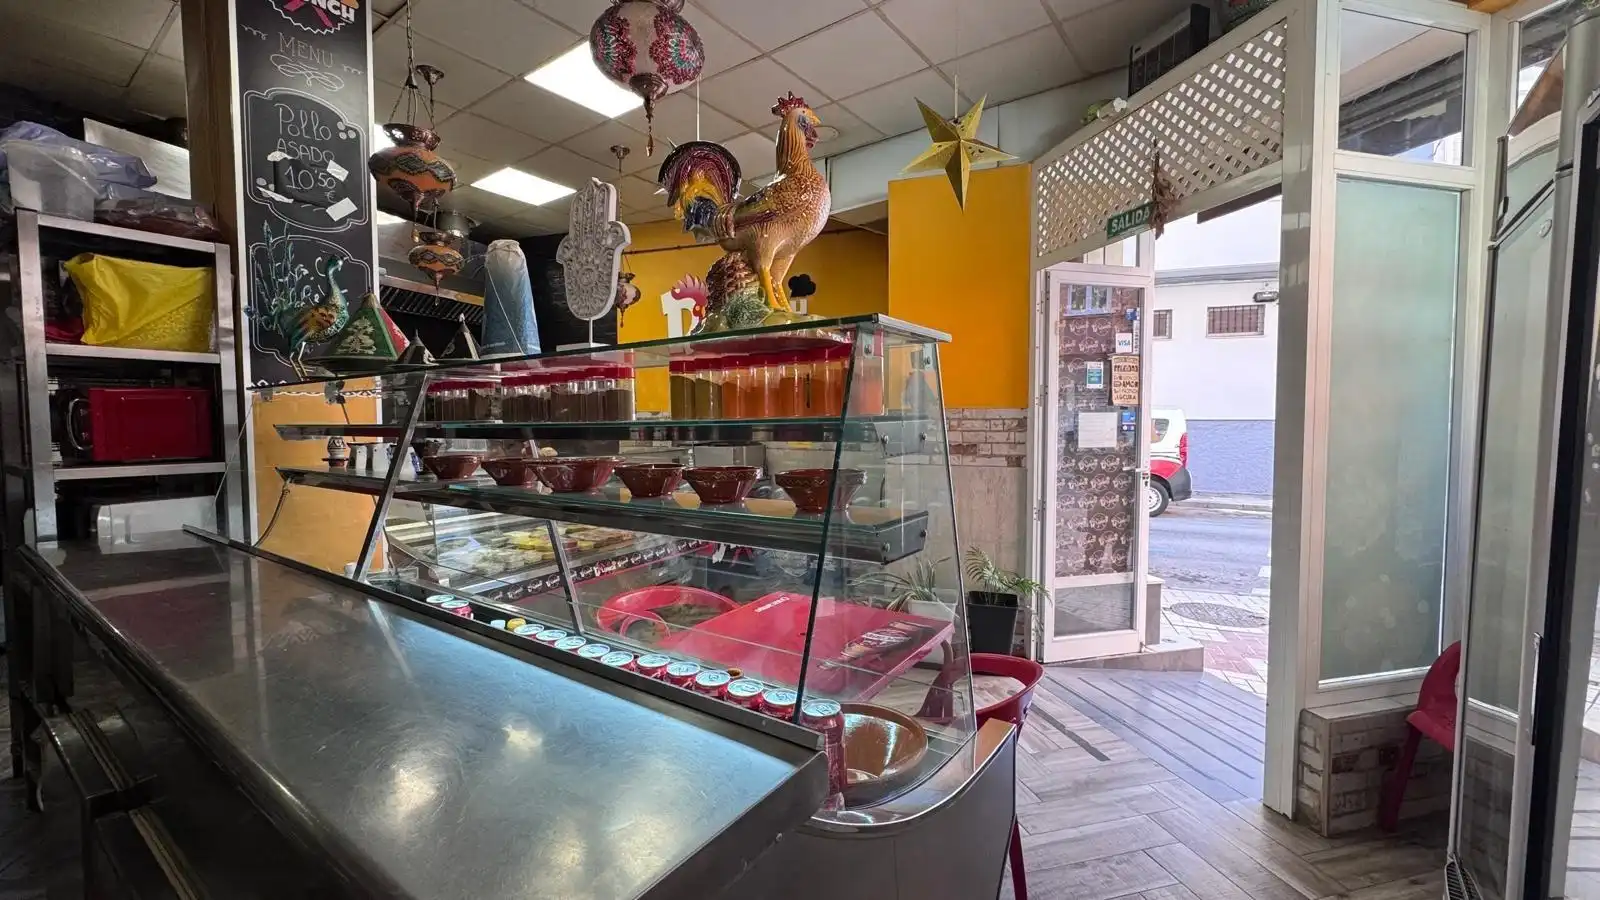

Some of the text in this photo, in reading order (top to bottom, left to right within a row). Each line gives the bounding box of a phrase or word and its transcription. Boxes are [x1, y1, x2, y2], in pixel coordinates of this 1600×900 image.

[304, 0, 355, 21] NCH
[278, 32, 333, 68] MENU
[277, 138, 335, 163] ASADO
[1111, 206, 1151, 233] SALIDA
